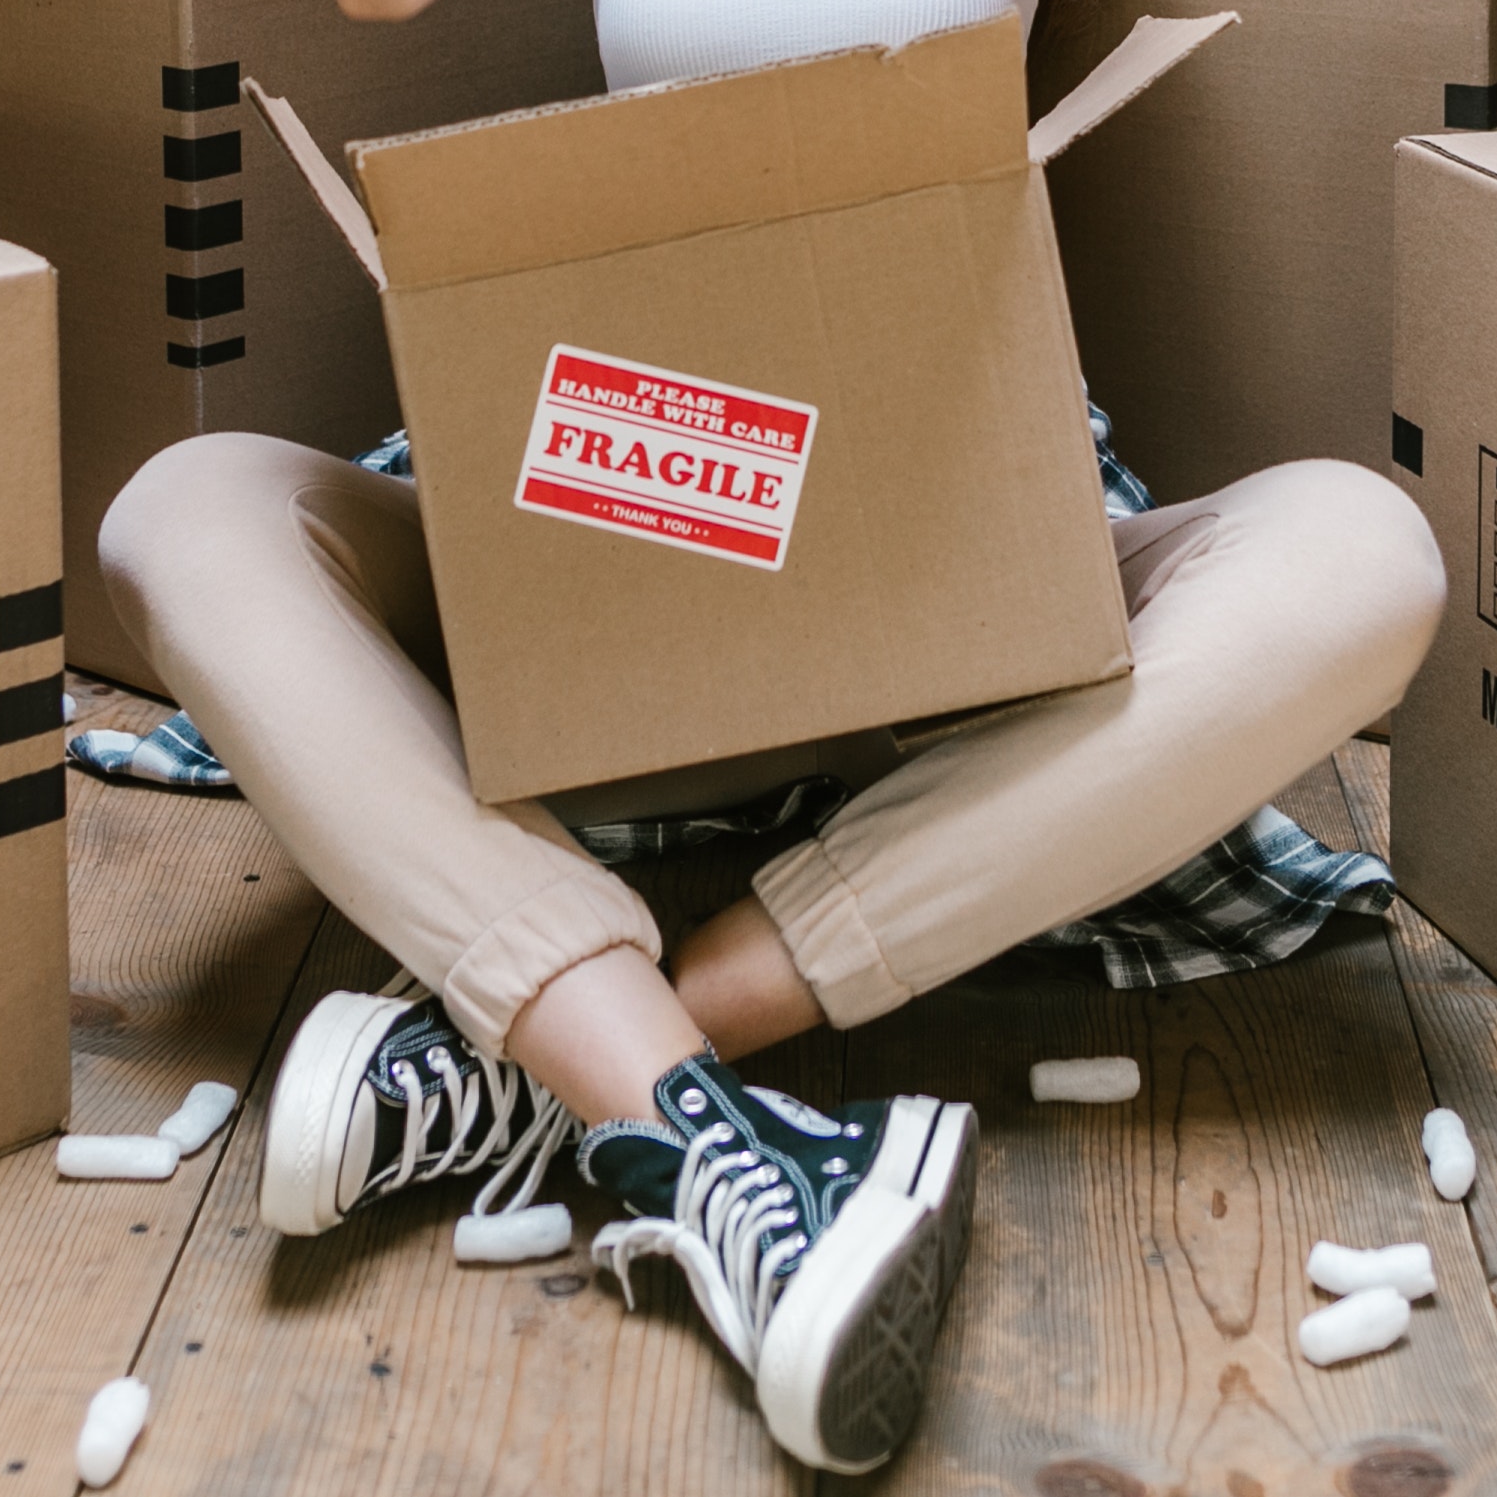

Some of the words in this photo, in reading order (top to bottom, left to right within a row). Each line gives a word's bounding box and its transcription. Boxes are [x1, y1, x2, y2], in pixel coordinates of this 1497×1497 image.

[557, 378, 656, 416] HANDLE
[662, 403, 726, 434] WITH
[731, 420, 796, 450] CARE
[635, 380, 726, 415] PLEASE
[544, 421, 784, 510] FRAGILE
[611, 503, 658, 528] THANK
[662, 517, 692, 536] YOU
